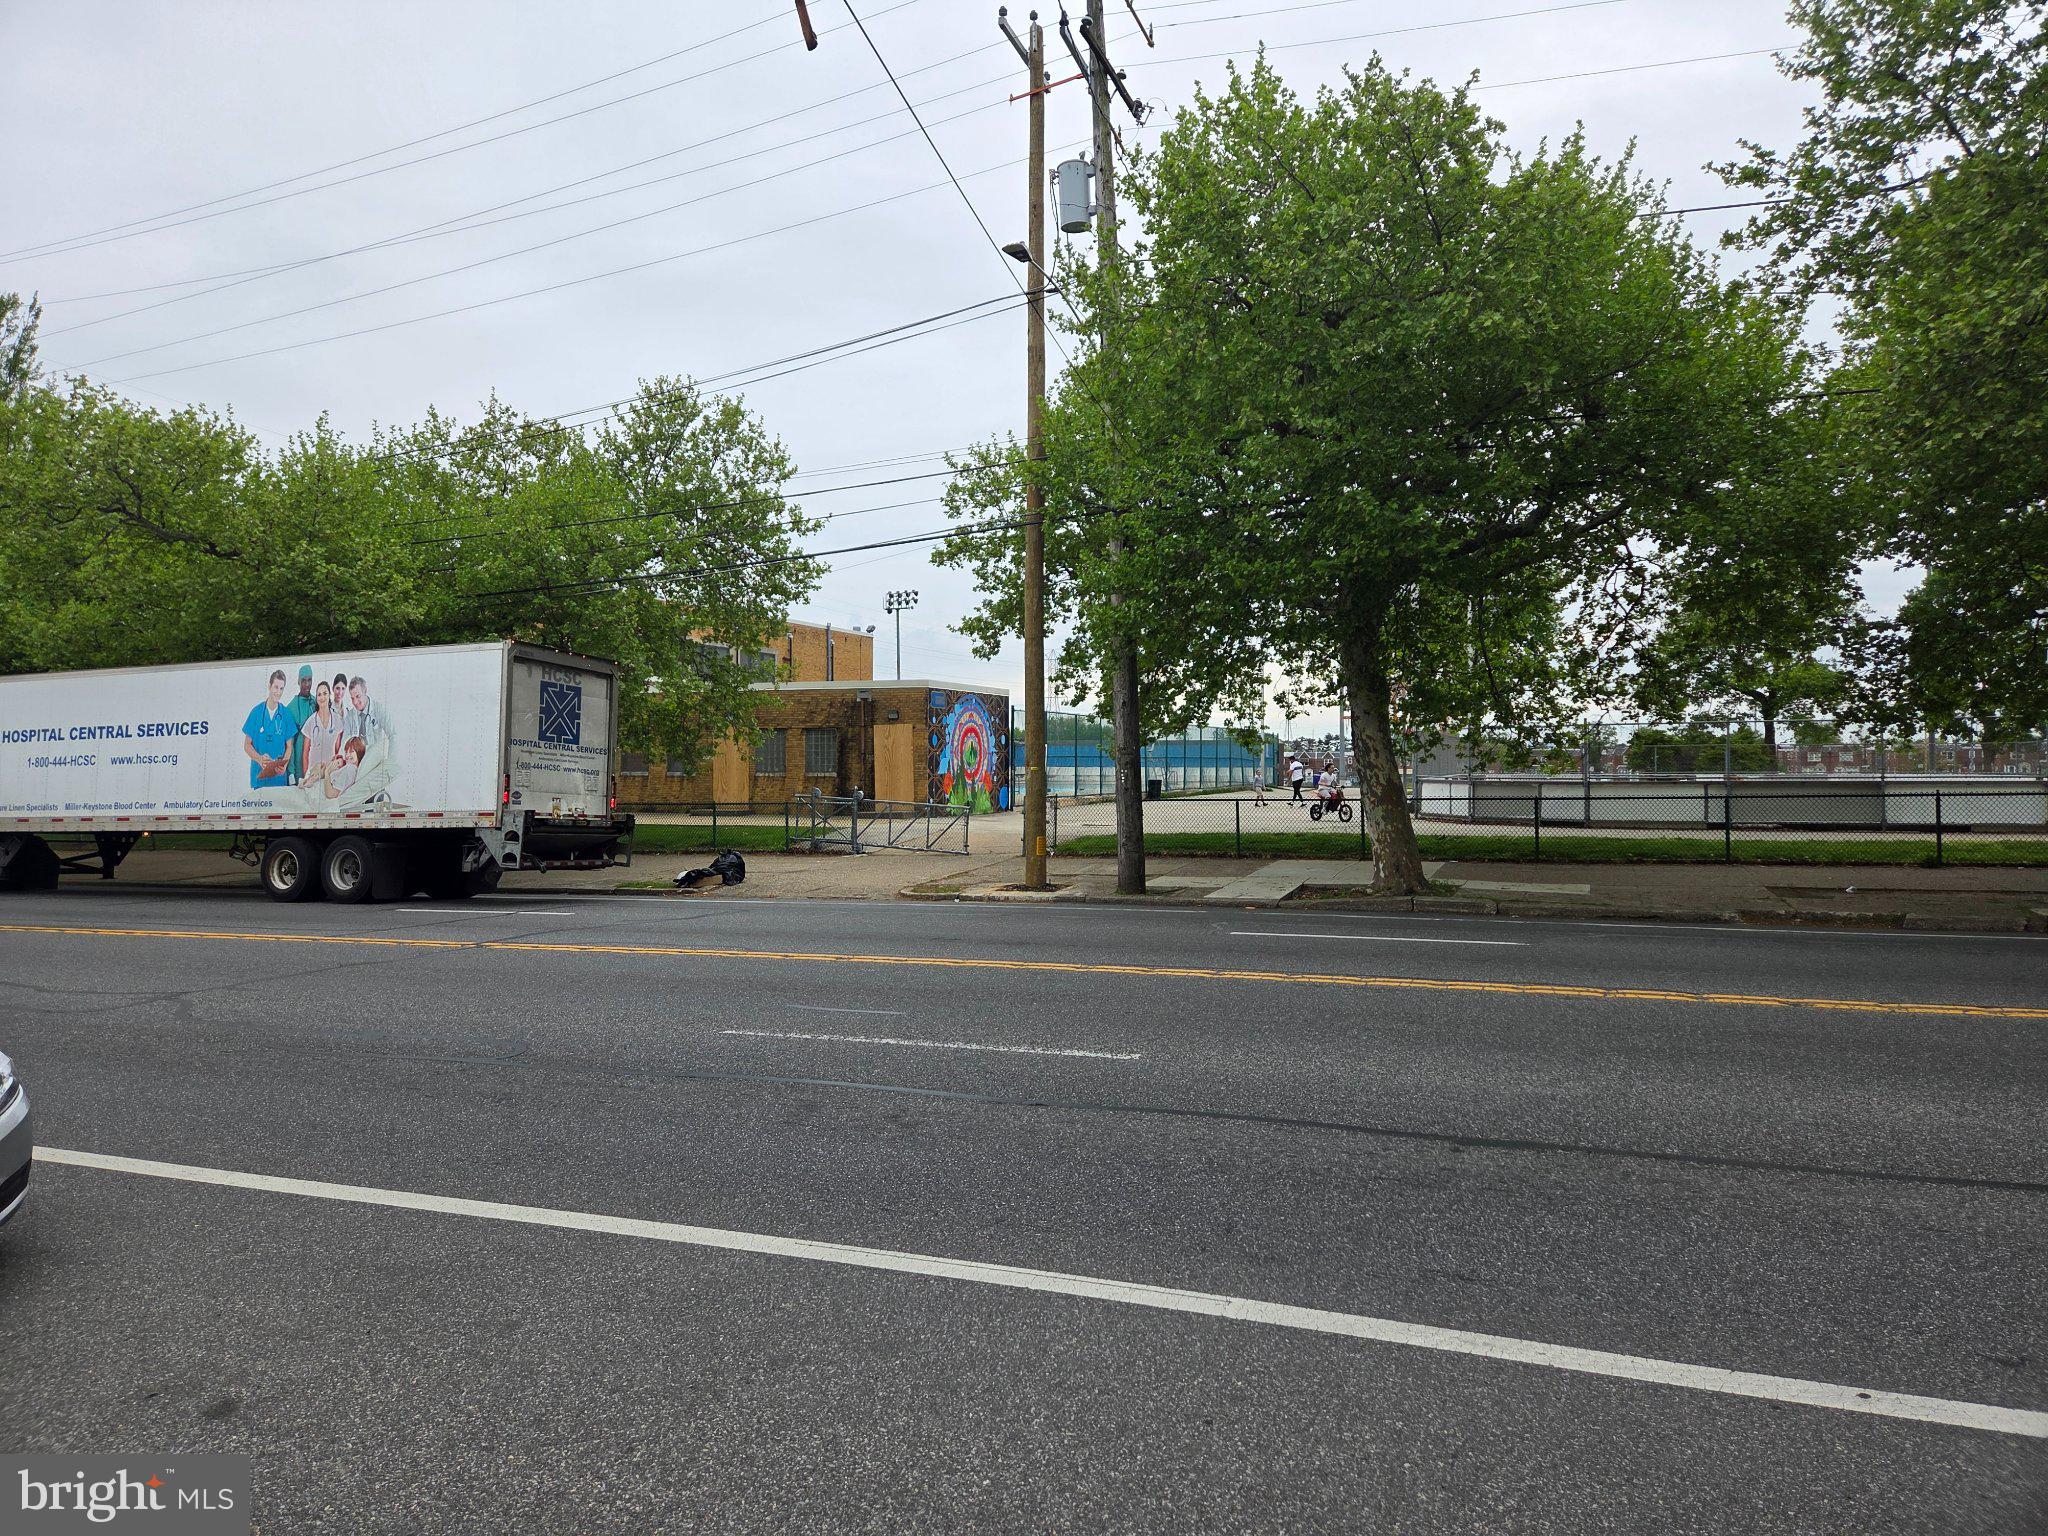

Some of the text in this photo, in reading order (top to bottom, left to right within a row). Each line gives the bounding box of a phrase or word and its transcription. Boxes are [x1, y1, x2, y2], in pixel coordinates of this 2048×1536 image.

[2, 720, 209, 743] HOSPITAL CENTRAL SERVICES
[543, 742, 575, 752] CENTRAL
[576, 746, 608, 756] SERVICES
[27, 753, 178, 768] 1-800-444-HCSC www.hcsc.org
[26, 803, 59, 813] Specialists
[65, 801, 157, 811] Miller-Keystone Blood Center
[163, 798, 273, 810] Ambulatory Care Linen Services
